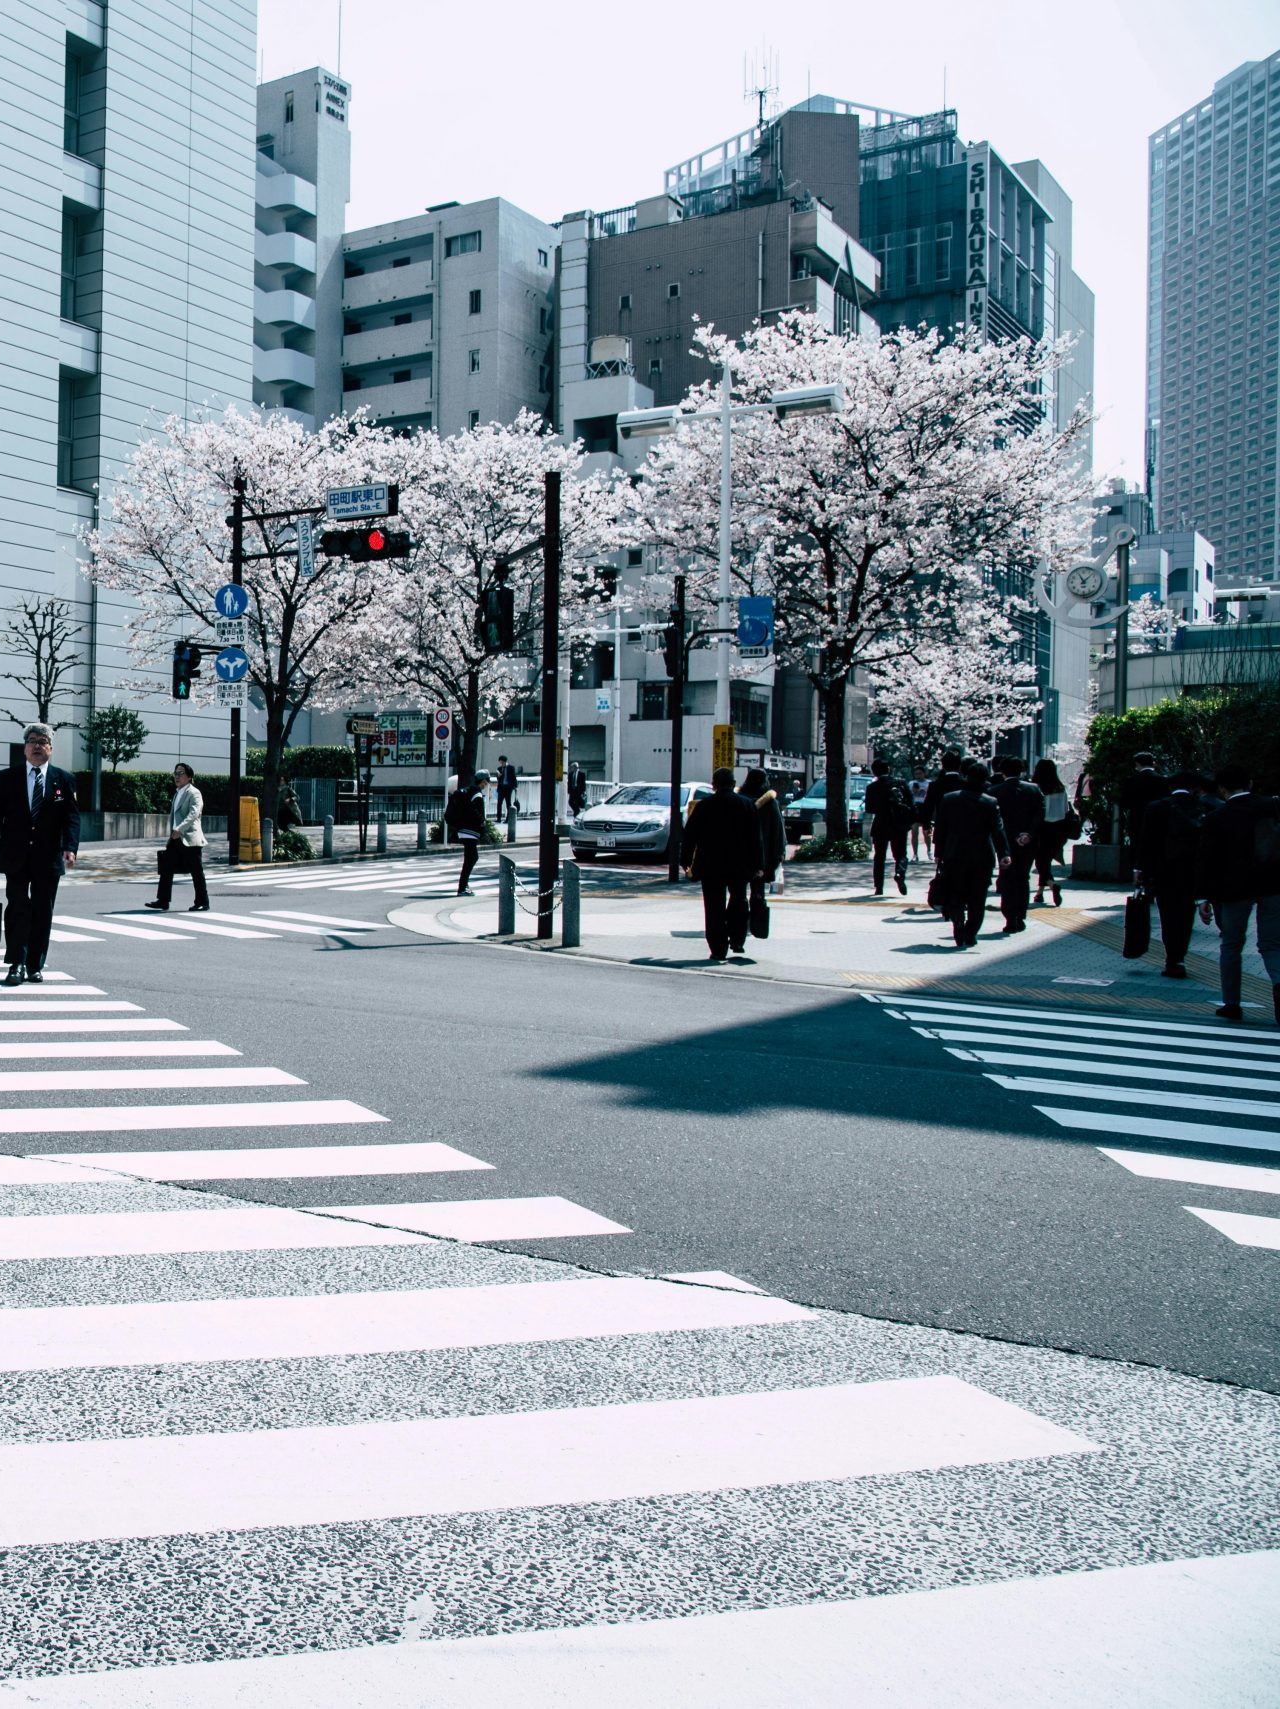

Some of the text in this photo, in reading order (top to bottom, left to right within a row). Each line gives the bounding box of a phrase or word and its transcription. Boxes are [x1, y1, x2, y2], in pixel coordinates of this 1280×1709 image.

[968, 162, 986, 329] SHIBAURA INS
[329, 487, 385, 506] 田町駅東口
[332, 506, 359, 515] Tamachi
[390, 751, 426, 764] Lepton
